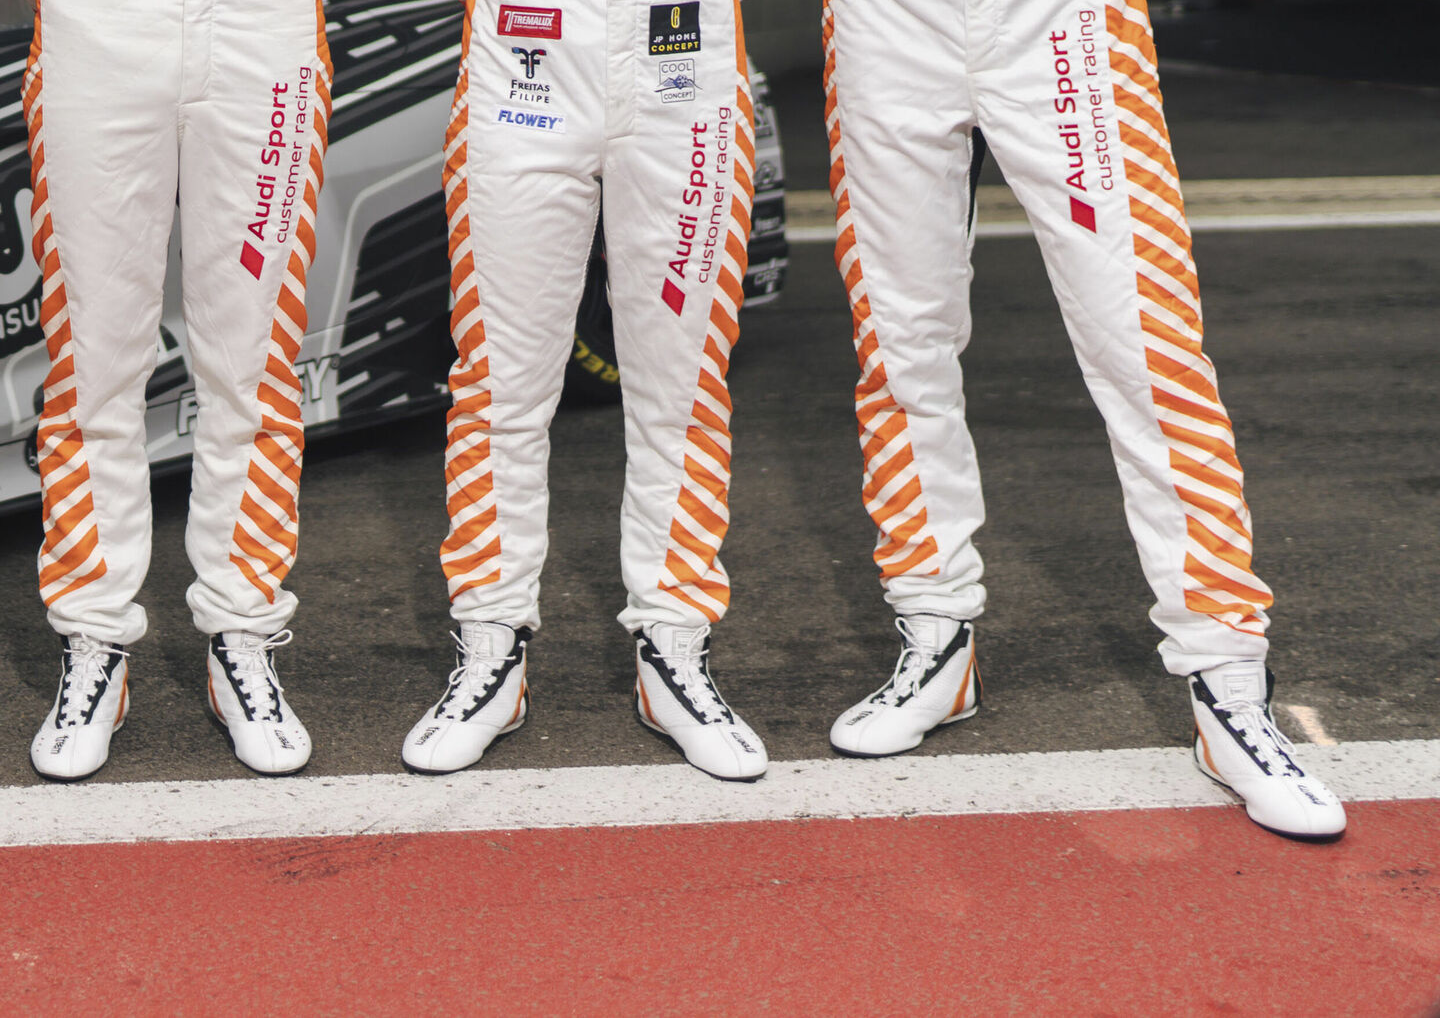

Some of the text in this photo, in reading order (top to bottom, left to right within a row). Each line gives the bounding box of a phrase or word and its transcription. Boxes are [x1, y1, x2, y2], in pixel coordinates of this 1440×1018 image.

[513, 15, 553, 28] TREMALUX
[653, 32, 696, 43] JP HOME
[651, 41, 699, 53] CONCEPT
[661, 63, 692, 74] COOL
[511, 80, 550, 93] FREITAS
[509, 90, 550, 104] FILIPE
[663, 91, 693, 100] CONCEPT
[1078, 10, 1113, 191] customer racing
[1049, 29, 1087, 192] Audi Sport
[498, 109, 559, 130] FLOWEY
[247, 82, 288, 241] Audi Sport
[277, 66, 311, 243] customer racing
[668, 121, 708, 279] Audi Sport
[698, 106, 731, 283] customer racing
